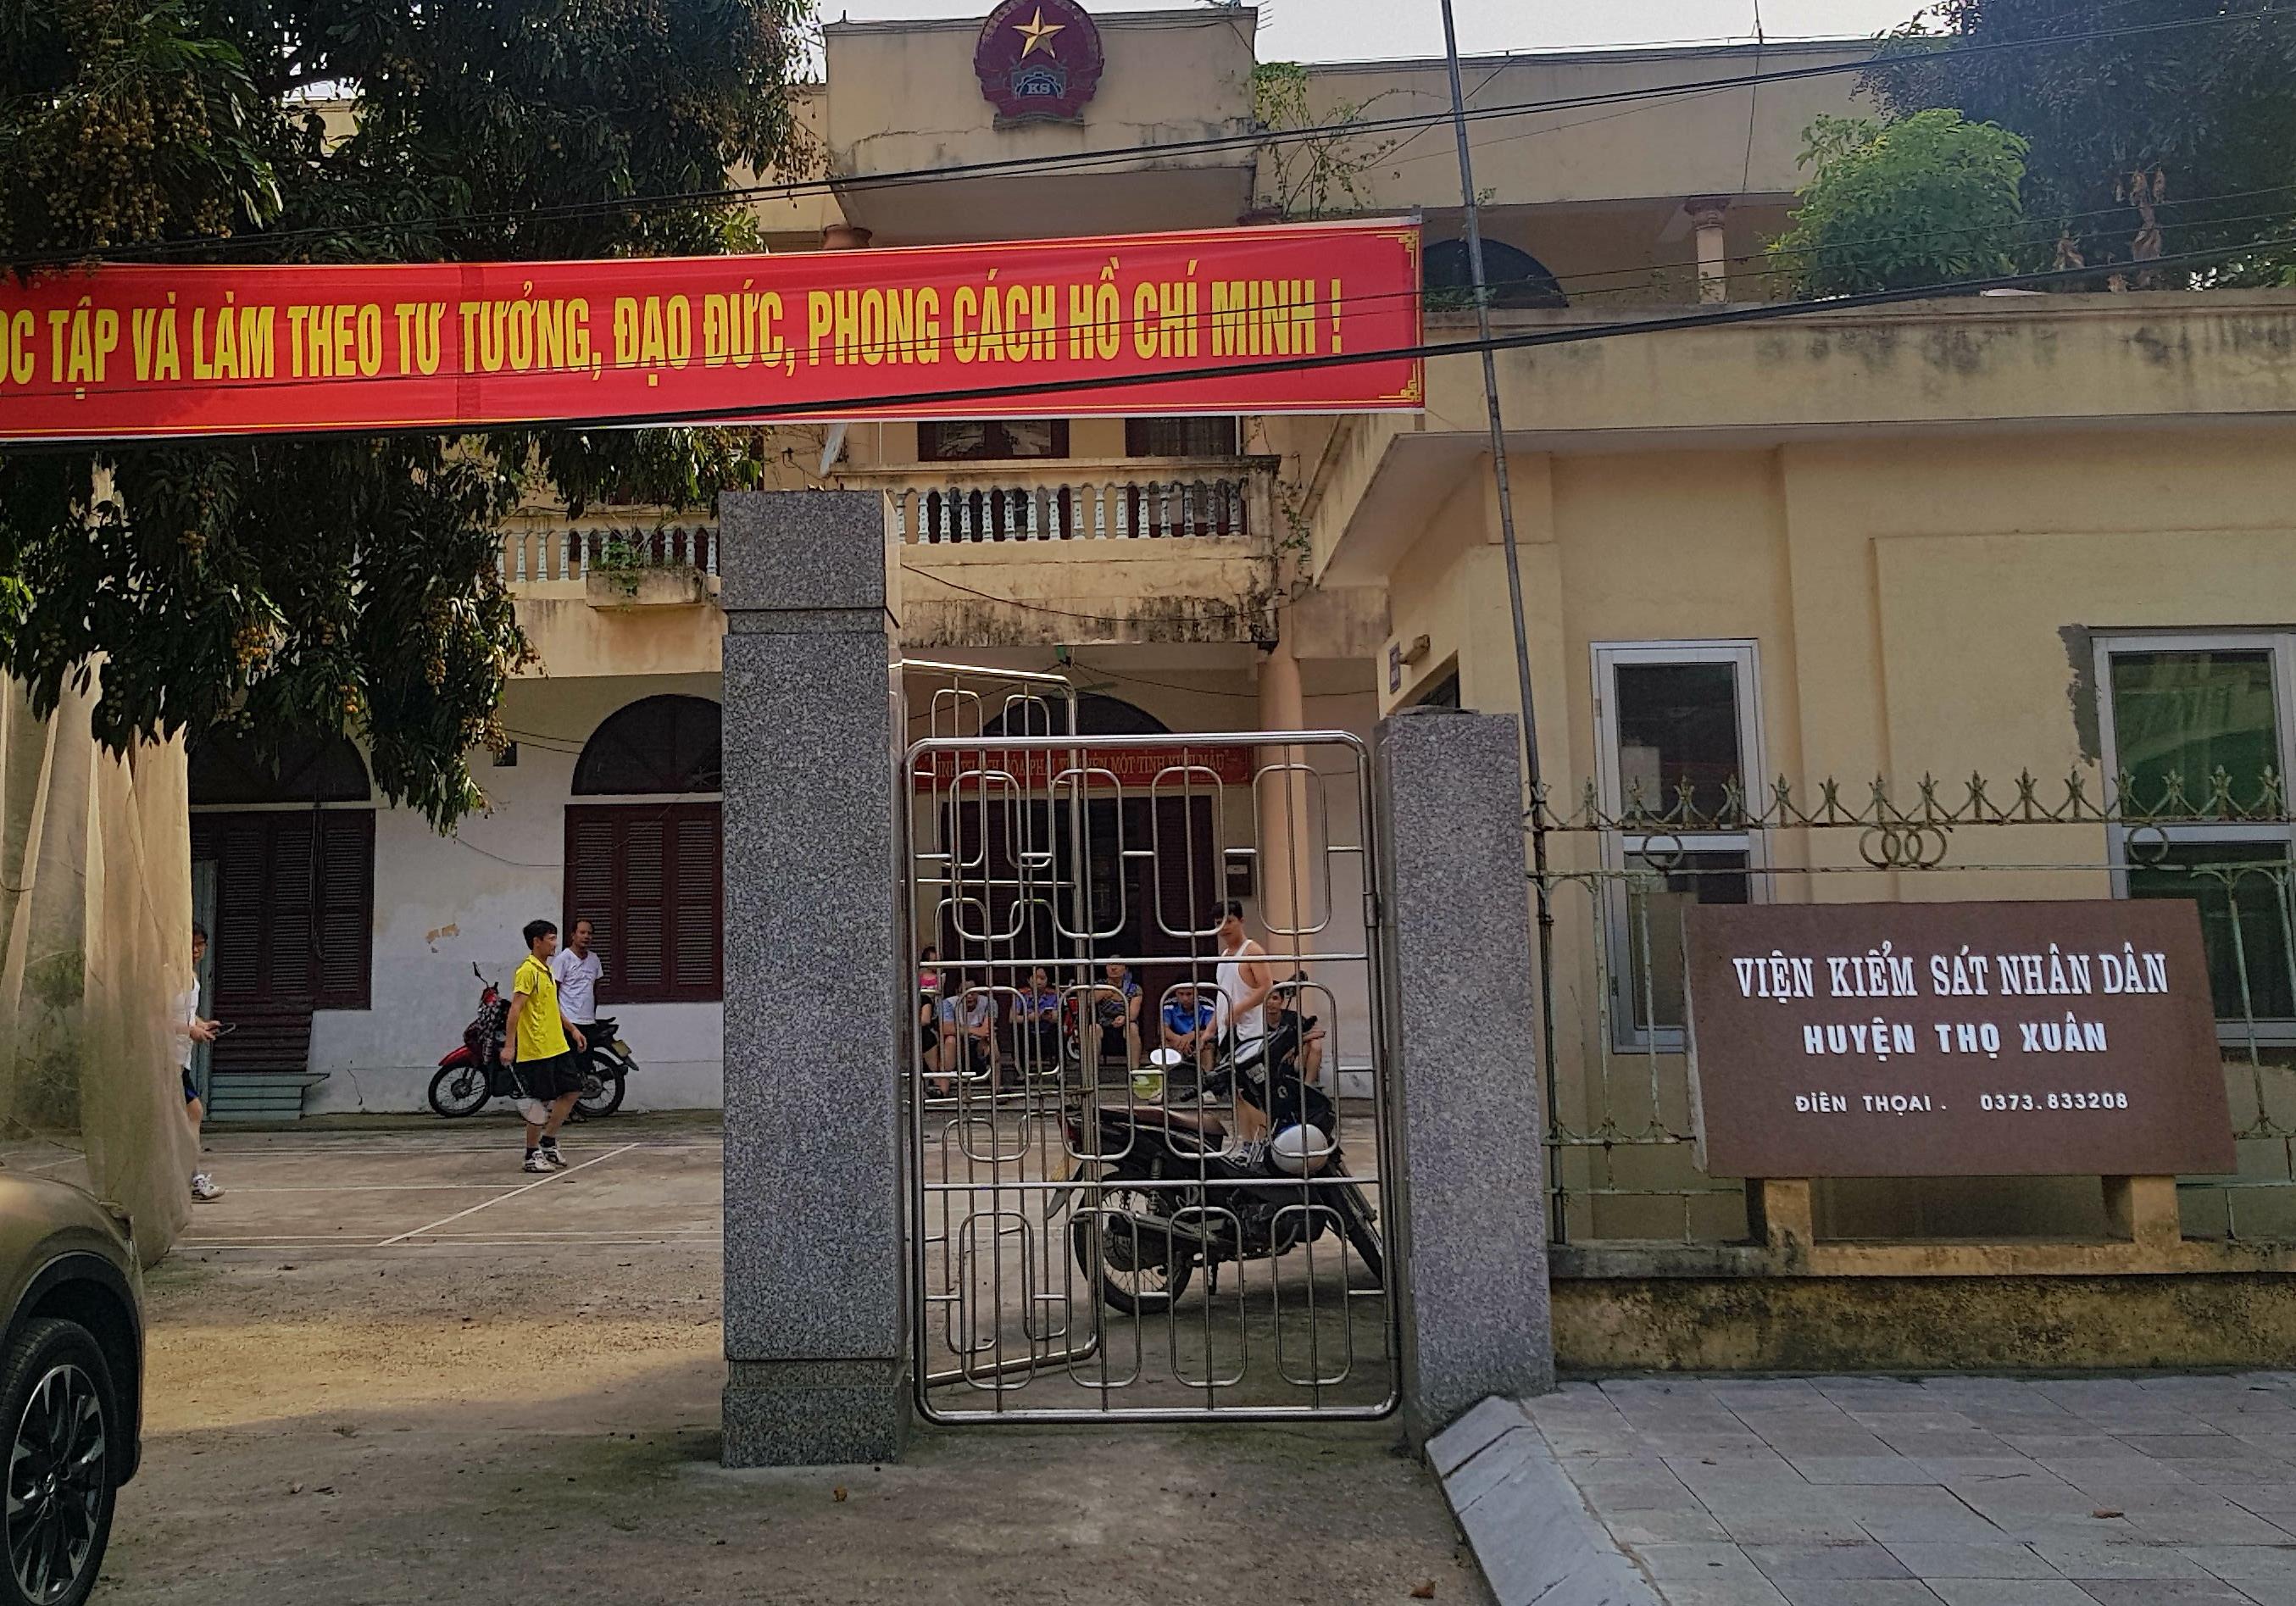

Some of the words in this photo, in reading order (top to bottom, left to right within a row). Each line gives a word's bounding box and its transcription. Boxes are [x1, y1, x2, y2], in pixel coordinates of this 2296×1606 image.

[47, 295, 120, 400] TẬP
[131, 291, 181, 381] VÀ
[192, 290, 275, 381] LÀM
[286, 303, 382, 378] THEO
[394, 302, 447, 375] TƯ
[459, 280, 603, 381] TƯỞNG,
[613, 294, 692, 387] ĐẠO
[703, 278, 796, 378] ĐỨC,
[808, 286, 940, 366] PHONG
[952, 268, 1057, 364] CÁCH
[1069, 256, 1120, 361] HỒ
[1133, 259, 1198, 358] CHÍ
[1211, 280, 1317, 357] MINH
[1732, 948, 1815, 1004] VIỆN
[1826, 939, 1920, 997] KIỂM
[1929, 943, 1990, 997] SÁT
[1996, 942, 2093, 996] NHÂN
[2098, 941, 2170, 994] DÂN
[1802, 1016, 1916, 1062] HUYỆN
[1933, 1022, 2001, 1059] THỌ
[2017, 1010, 2108, 1053] XUÂN
[1979, 1092, 2129, 1112] 0373.833208
